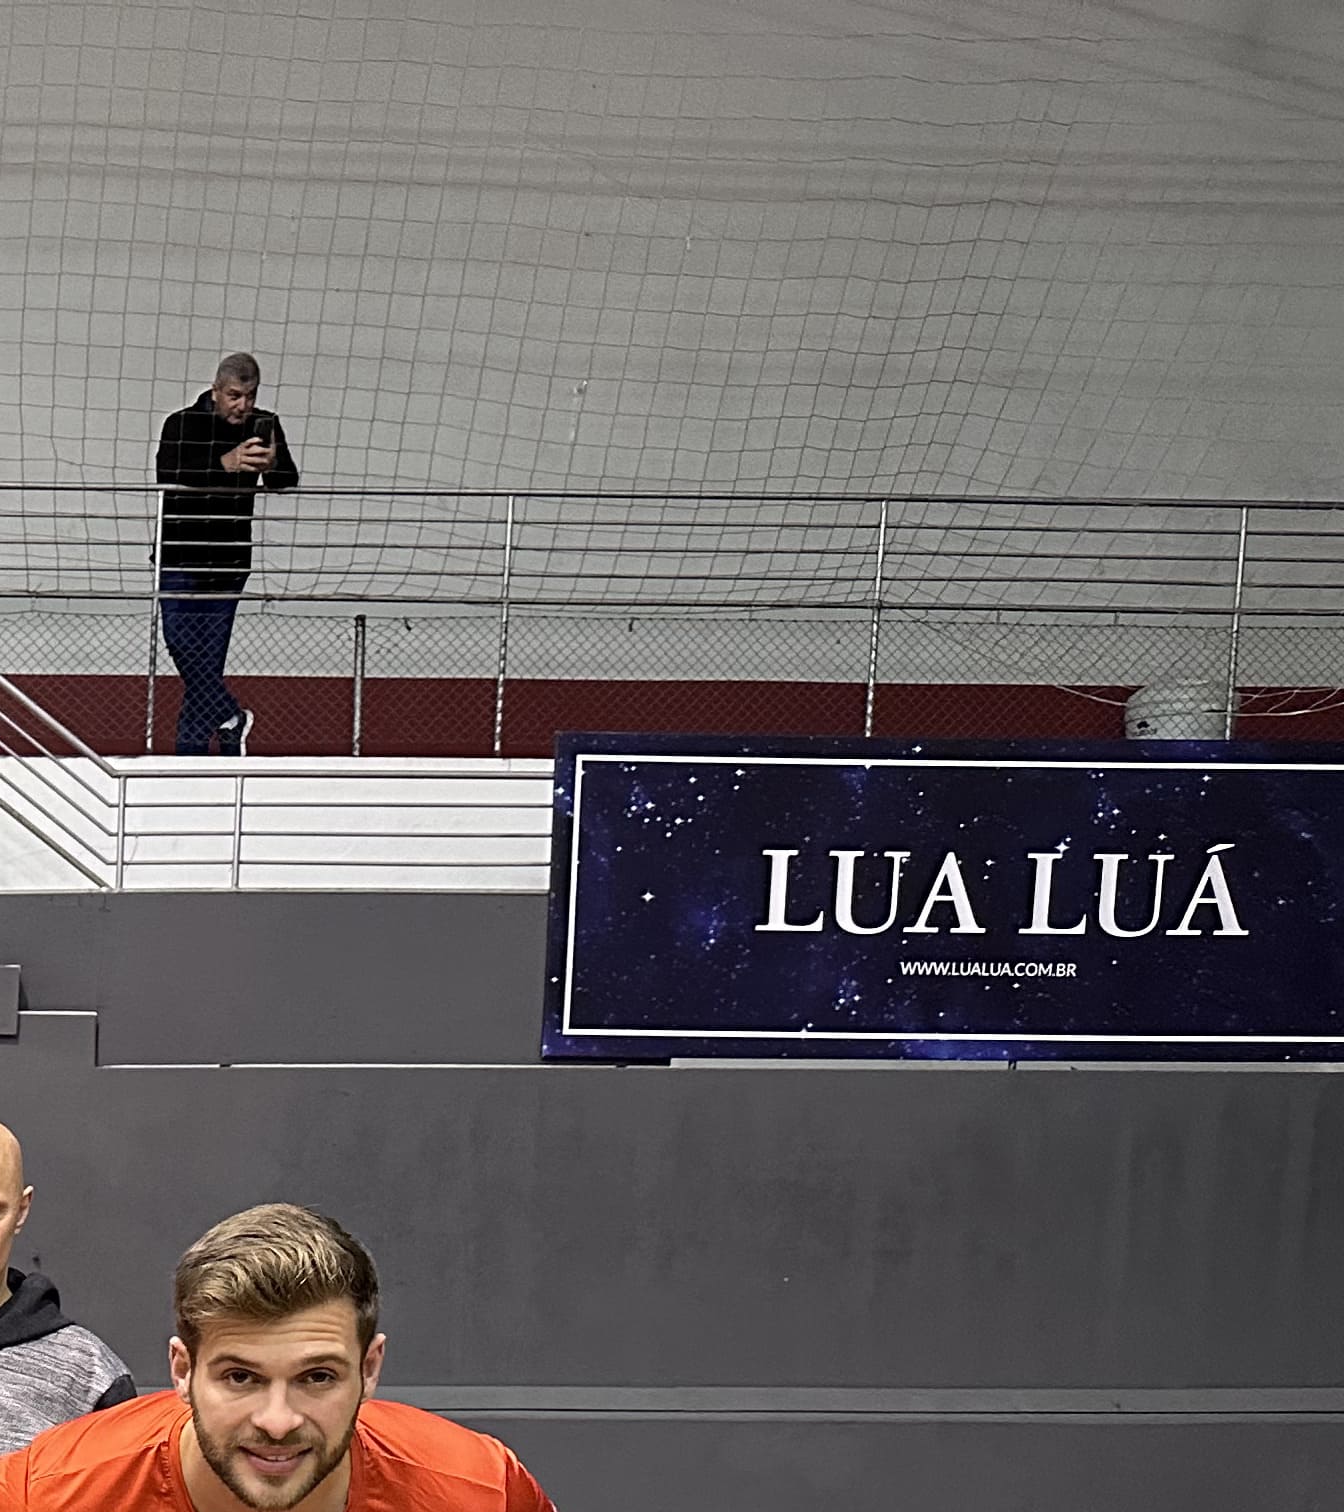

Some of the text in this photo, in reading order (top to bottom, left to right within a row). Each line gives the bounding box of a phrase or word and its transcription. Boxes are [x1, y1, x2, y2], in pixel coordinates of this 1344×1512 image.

[754, 843, 1249, 938] LUA LUÁ
[900, 961, 1077, 978] WWW.LUALUA.COM.BR
